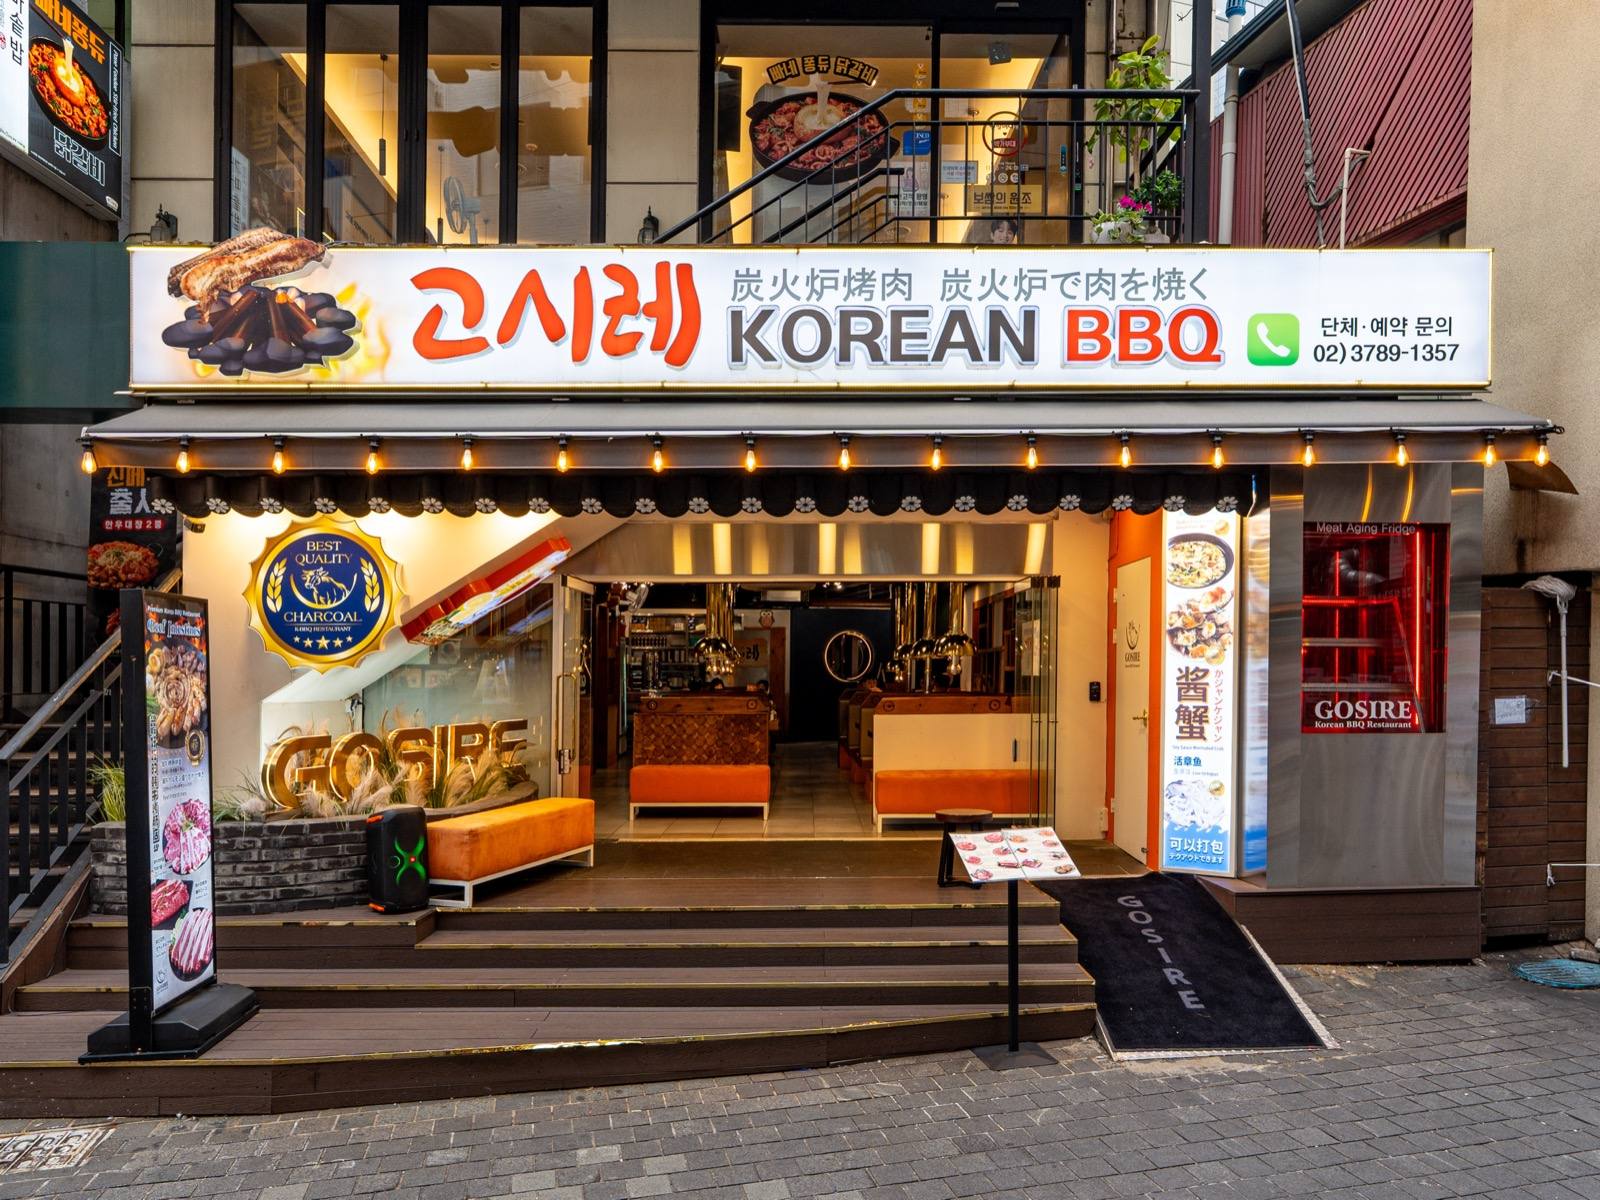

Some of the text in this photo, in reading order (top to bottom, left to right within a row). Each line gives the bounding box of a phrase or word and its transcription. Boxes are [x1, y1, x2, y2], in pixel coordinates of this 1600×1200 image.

[802, 55, 830, 74] 퐁듀
[834, 56, 878, 85] 닭갈비
[53, 126, 106, 187] 닭갈비
[731, 267, 913, 302] 炭火炉烤肉
[940, 267, 1207, 302] 炭火炉で肉を焼く
[410, 261, 701, 367] 고시레
[729, 307, 1223, 364] KOREAN BBQ
[1415, 316, 1452, 337] 문의
[1313, 343, 1460, 364] 02)3789-1357
[1316, 523, 1415, 536] Meat Aging Fridge
[306, 541, 342, 551] BEST
[295, 553, 352, 566] QUALITY
[283, 611, 363, 622] CHARCOAL
[1314, 700, 1412, 720] GOSIRE
[1315, 720, 1412, 730] Korean BBQ Restaurant
[1169, 837, 1225, 855] 可以打包
[1117, 895, 1206, 1009] GOSIRE
